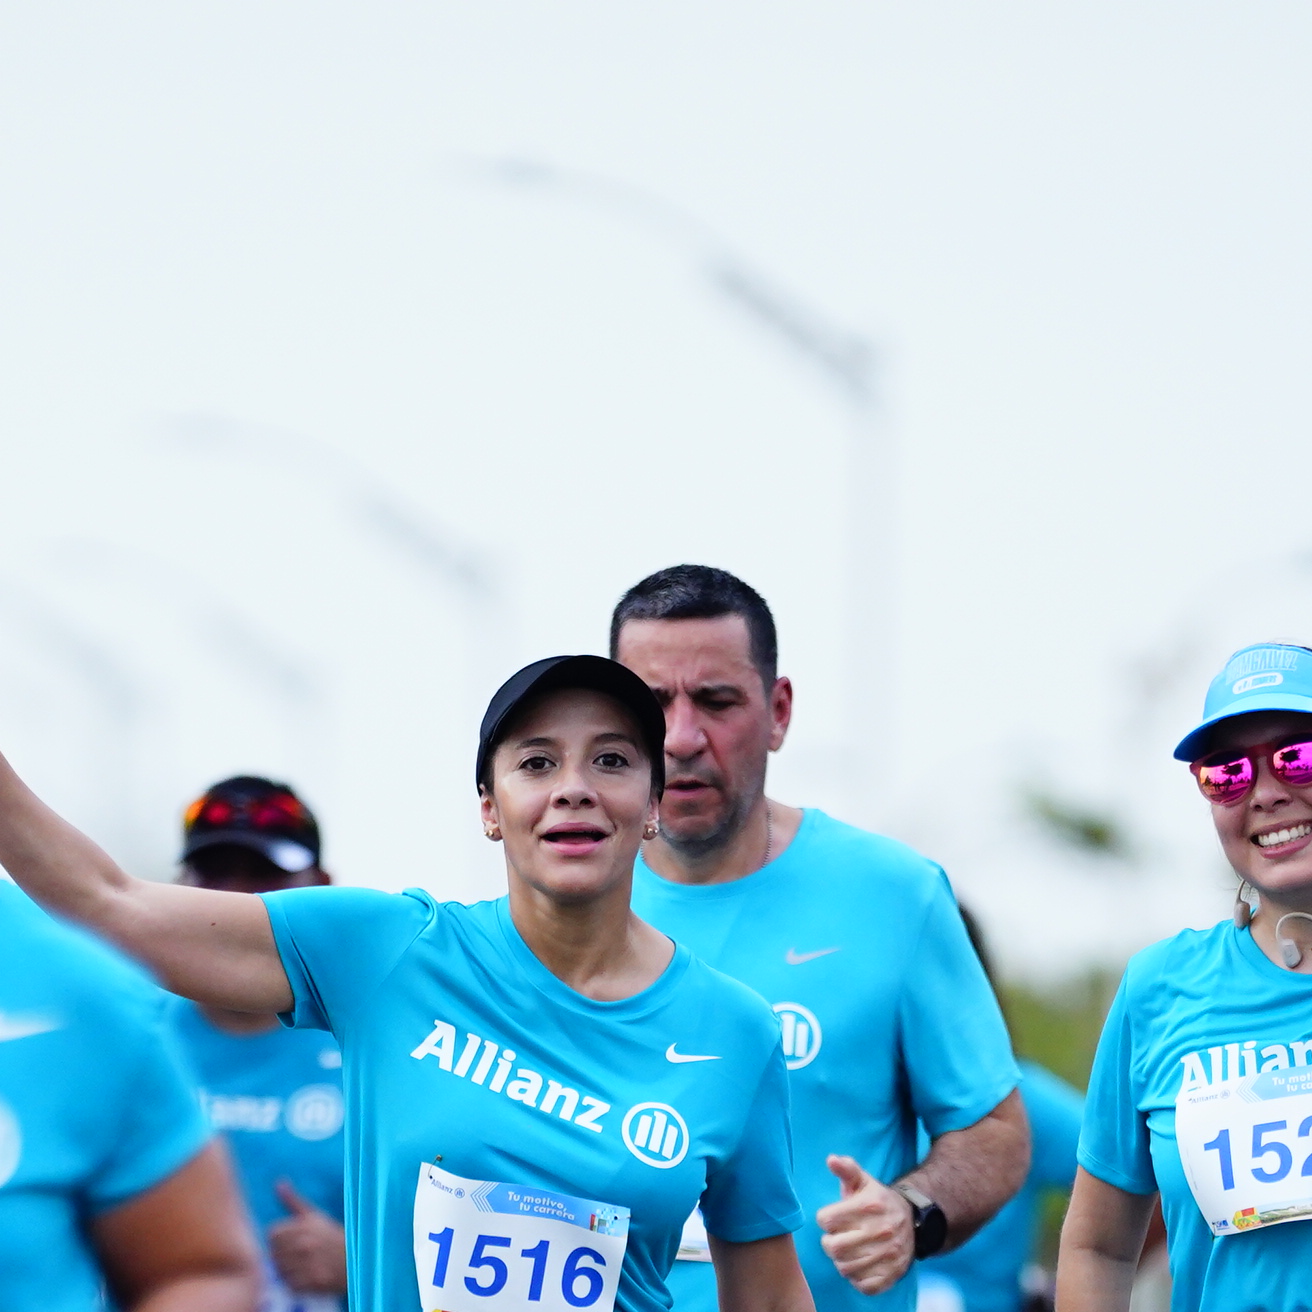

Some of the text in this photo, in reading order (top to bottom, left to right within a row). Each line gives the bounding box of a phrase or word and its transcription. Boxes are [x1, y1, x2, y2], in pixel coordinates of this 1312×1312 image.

[410, 1019, 611, 1134] Allianz
[1272, 1076, 1285, 1086] Tu
[507, 1191, 567, 1212] Tu motivo,
[533, 1205, 575, 1221] carrera
[427, 1226, 607, 1308] 1516
